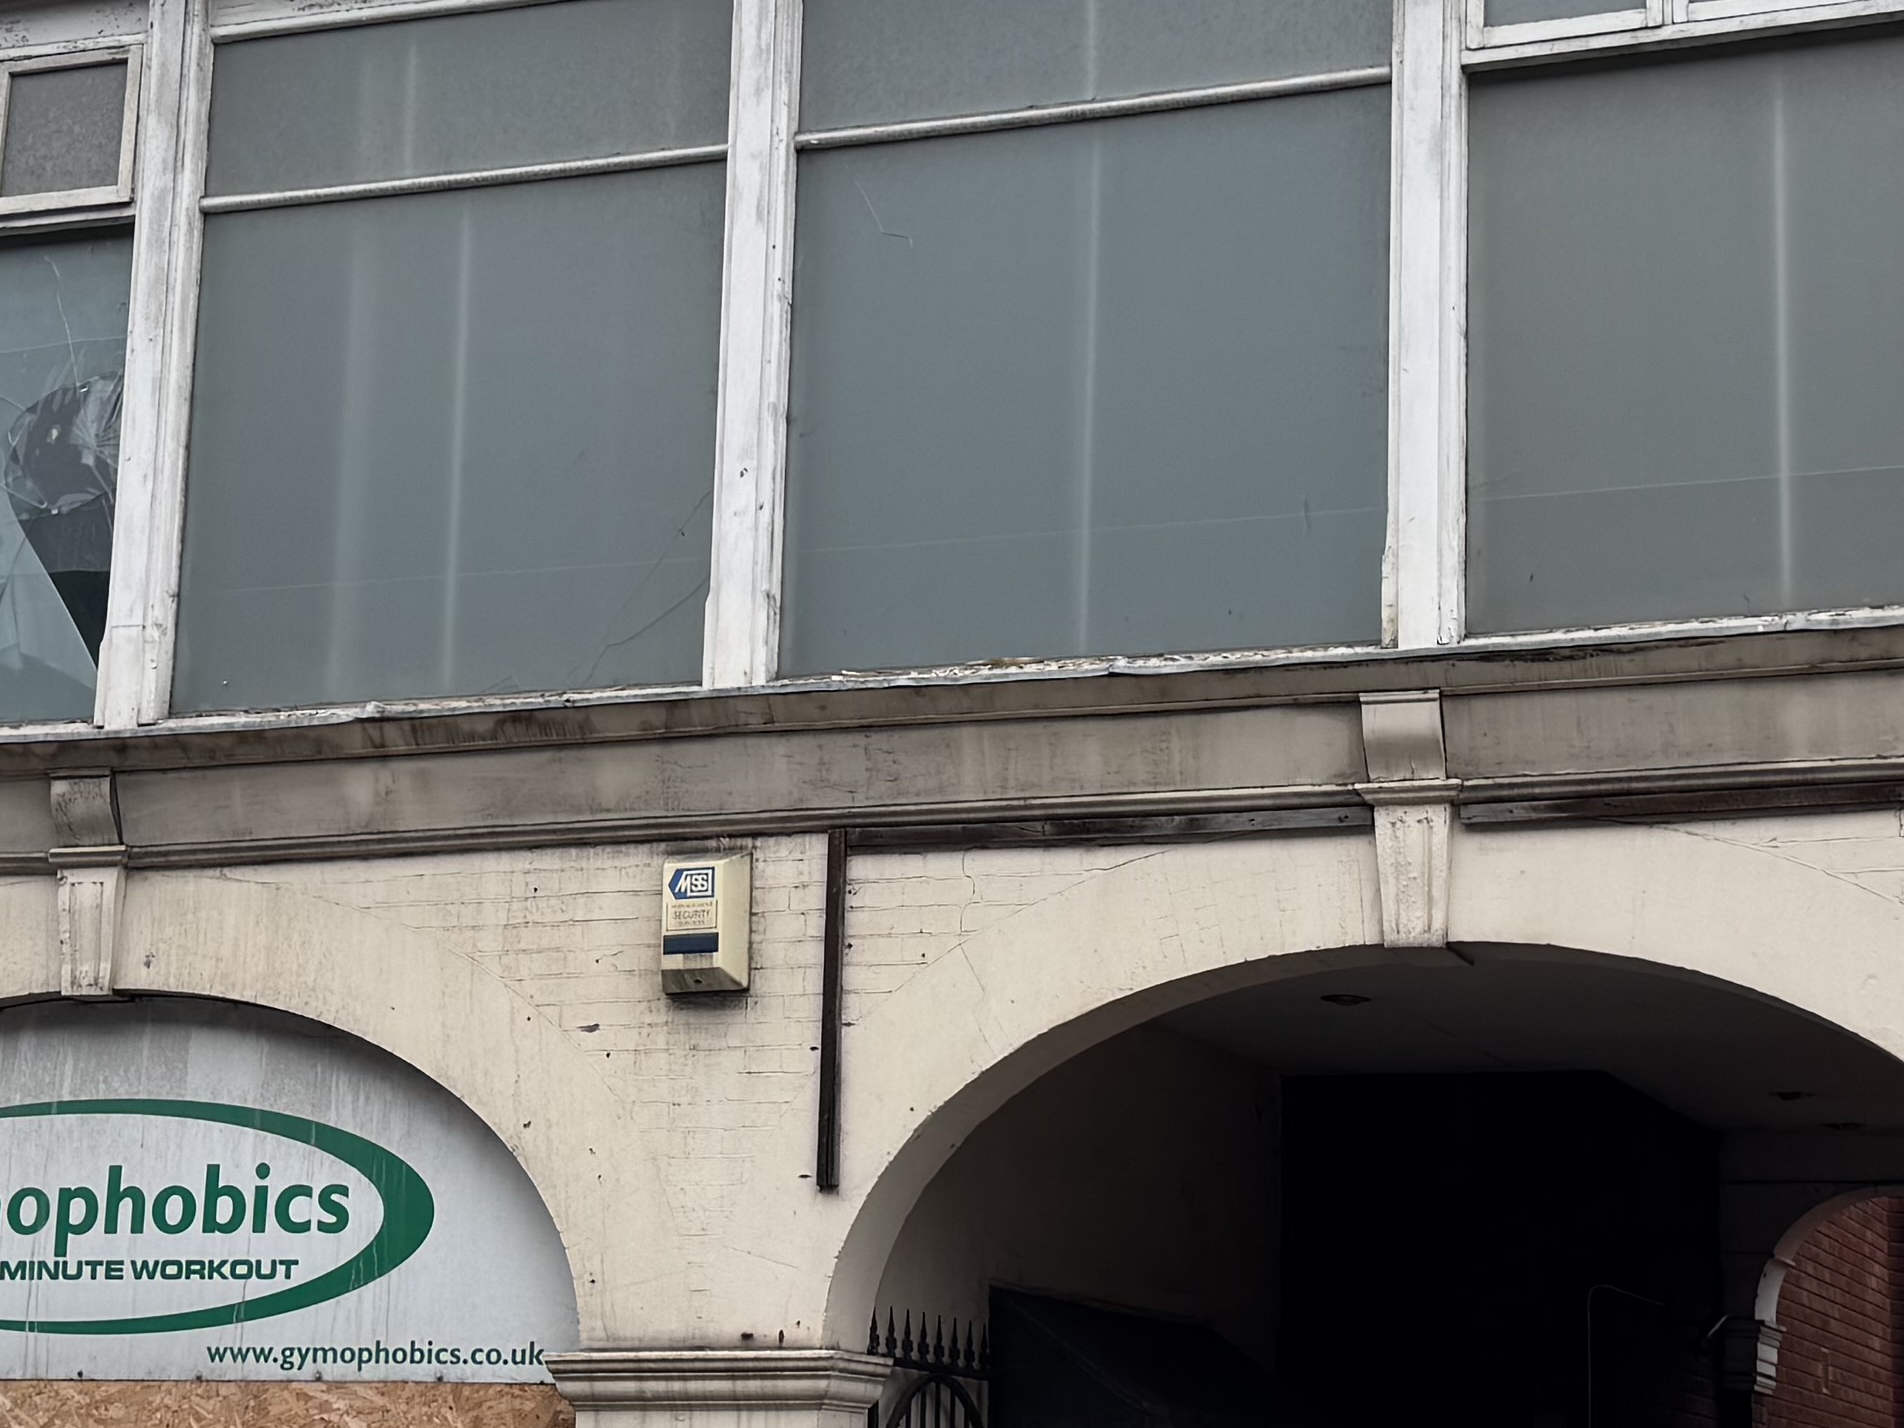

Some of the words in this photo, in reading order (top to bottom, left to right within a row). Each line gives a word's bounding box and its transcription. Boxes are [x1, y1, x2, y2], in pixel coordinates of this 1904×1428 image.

[675, 871, 709, 894] MSS
[0, 1259, 125, 1281] MINUTE
[131, 1259, 299, 1279] WORKOUT
[207, 1340, 545, 1371] www.gymophobics.co.uk
